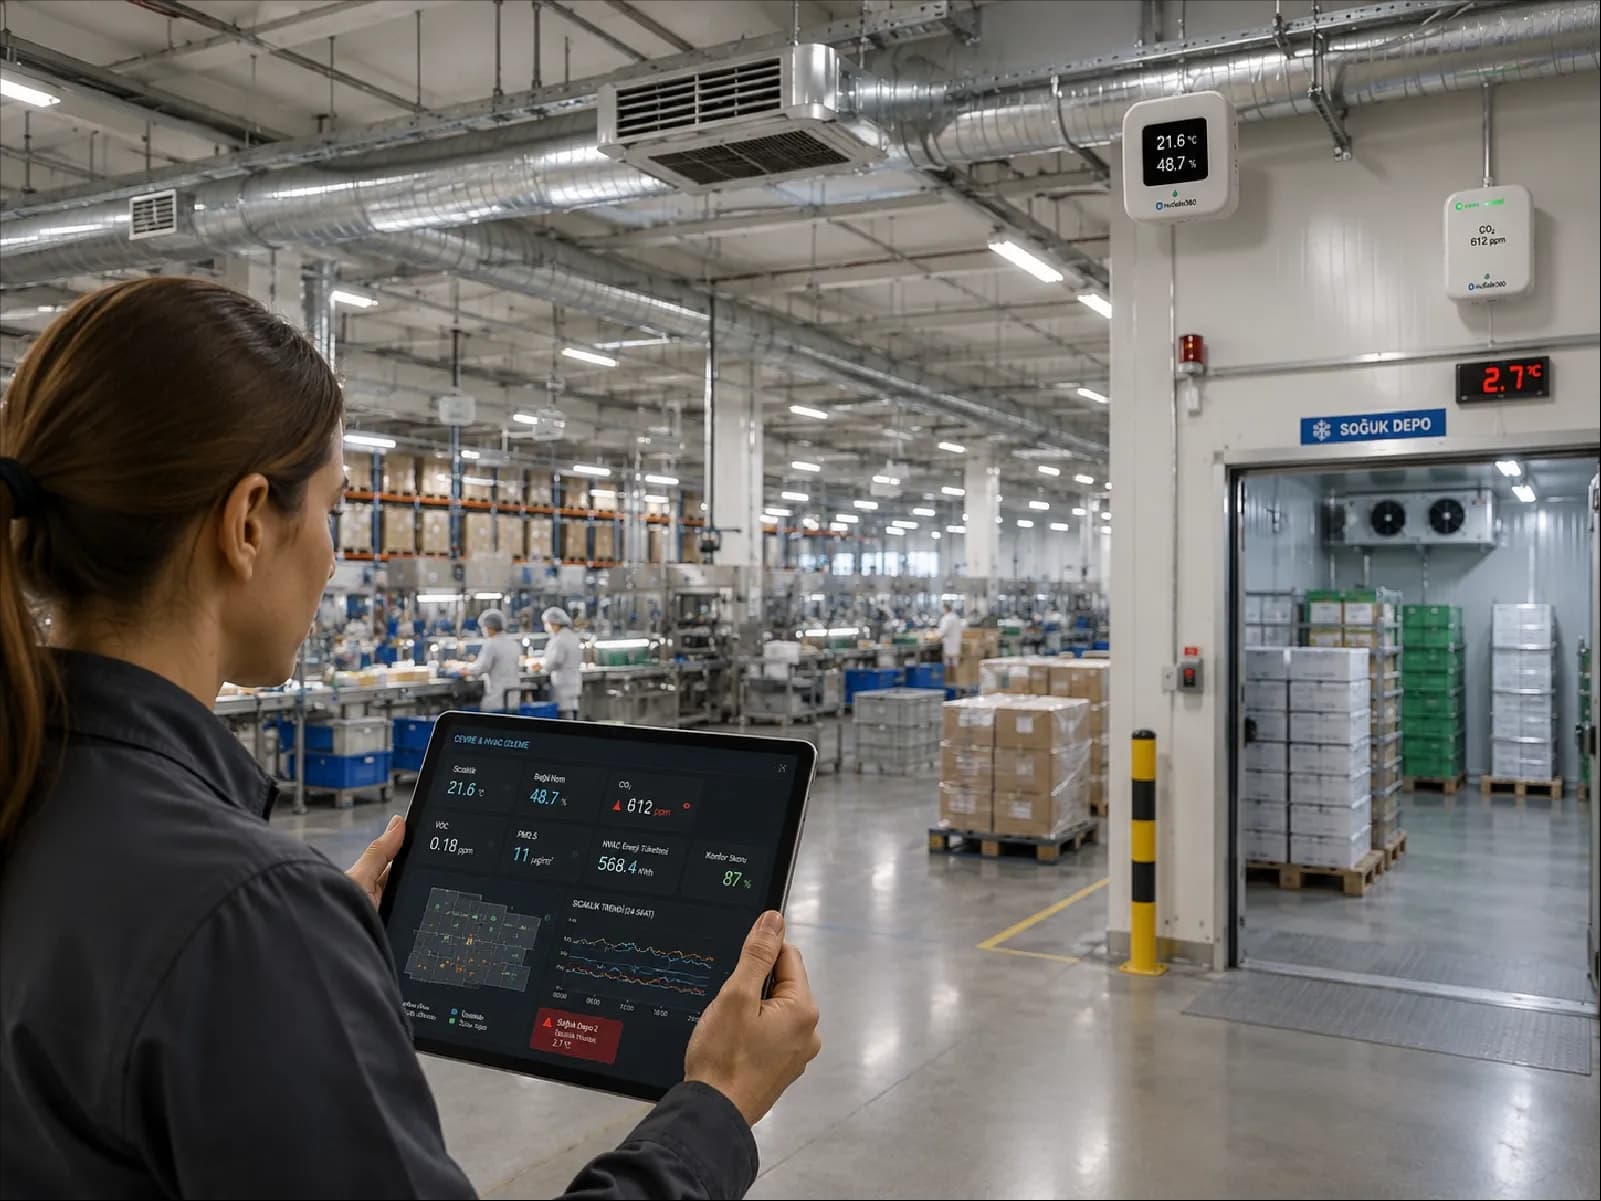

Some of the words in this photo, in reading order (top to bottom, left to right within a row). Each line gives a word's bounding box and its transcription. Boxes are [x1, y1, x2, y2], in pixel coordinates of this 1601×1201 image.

[1156, 134, 1186, 151] 21.6
[1156, 155, 1186, 172] 48.7
[1470, 237, 1488, 246] 612
[1489, 237, 1506, 247] ppm
[1482, 364, 1524, 395] 2.7
[1340, 419, 1389, 437] SOĞUK
[1393, 417, 1431, 433] DEPO
[447, 780, 477, 797] 21.6
[530, 788, 560, 805] 48.7
[627, 798, 653, 815] 612
[429, 836, 458, 852] 0.18
[458, 847, 474, 856] ppm
[513, 847, 530, 863] 11
[597, 856, 638, 874] 568.4
[722, 870, 743, 887] 87
